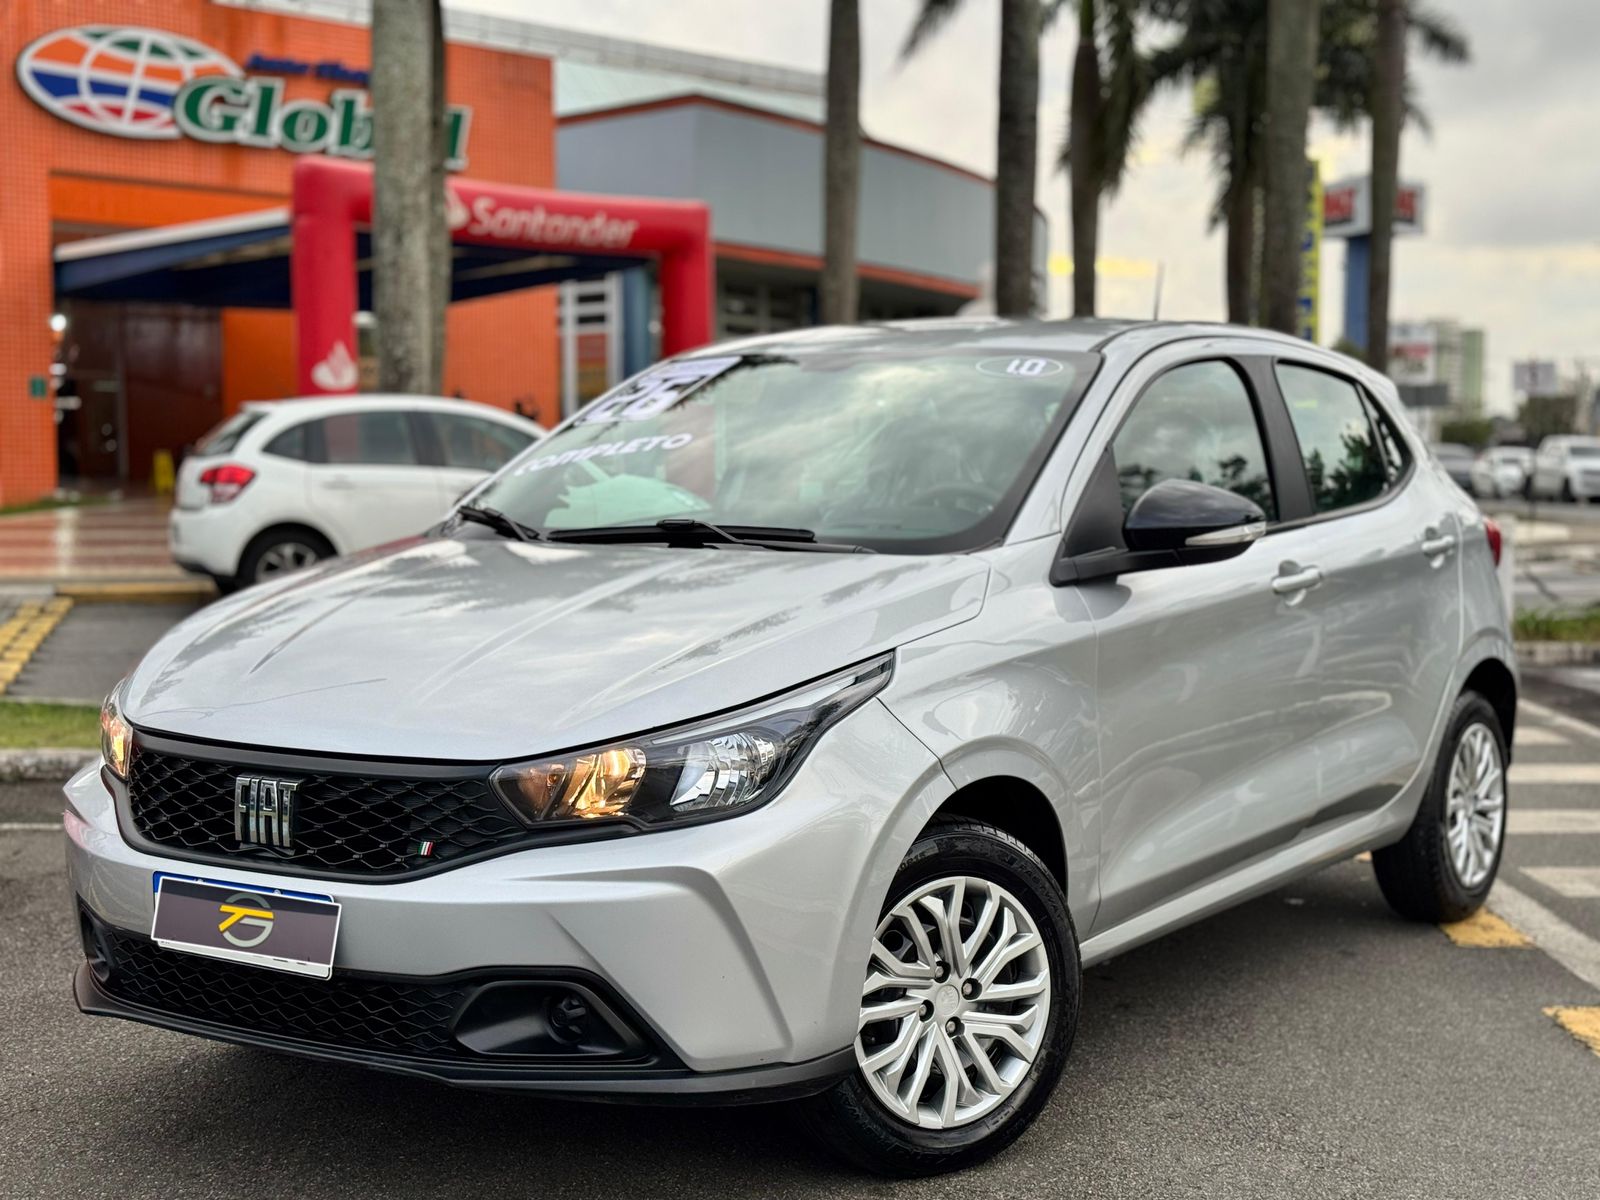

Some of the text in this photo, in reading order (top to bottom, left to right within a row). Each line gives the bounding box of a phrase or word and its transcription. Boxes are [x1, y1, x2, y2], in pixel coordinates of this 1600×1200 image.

[174, 74, 471, 170] Globl
[468, 196, 640, 249] Santander
[514, 432, 692, 476] COMPLETO
[234, 776, 300, 848] FIAT
